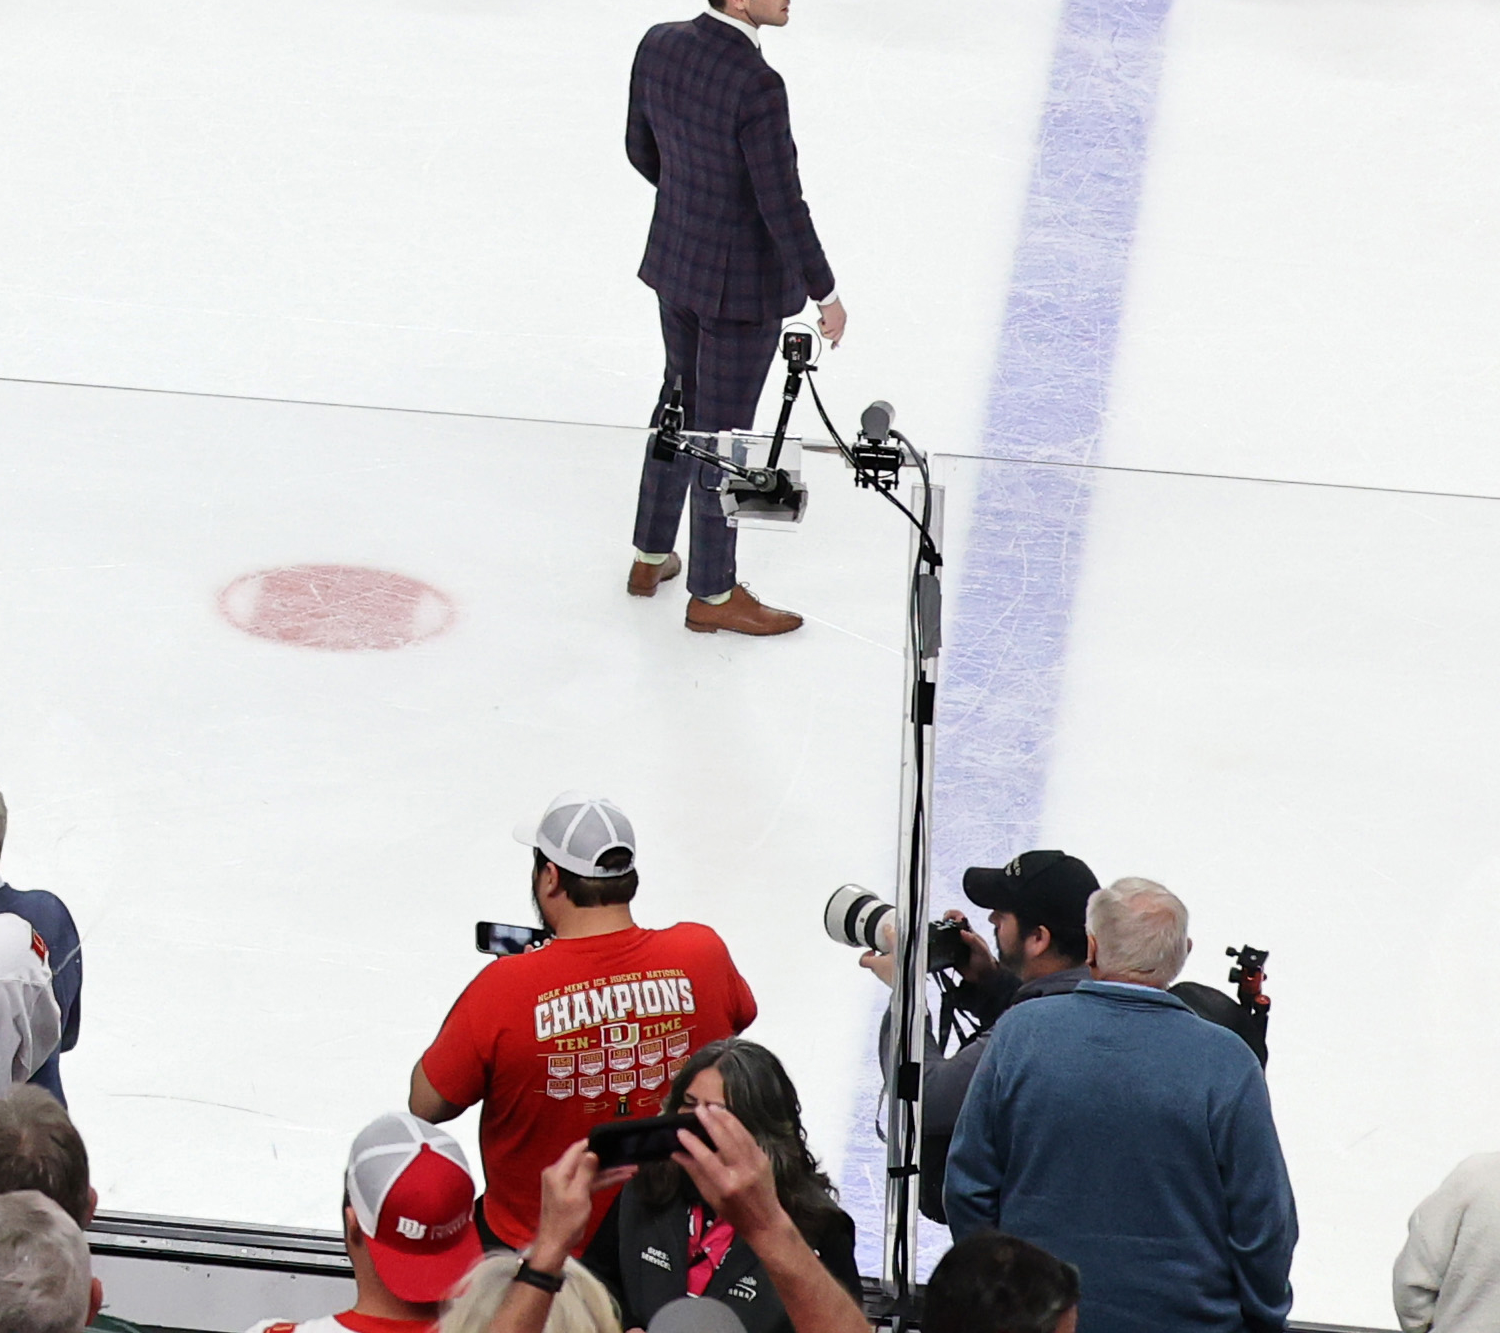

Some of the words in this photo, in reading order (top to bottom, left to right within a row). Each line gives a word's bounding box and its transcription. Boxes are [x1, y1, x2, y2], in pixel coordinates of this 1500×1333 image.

[536, 991, 560, 1004] NCAA
[562, 982, 589, 996] MEN'S
[591, 978, 605, 990] ICE
[607, 973, 643, 989] HOCKEY
[644, 968, 686, 983] NATIONAL
[533, 976, 697, 1042] CHAMPIONS
[600, 1022, 639, 1049] DU
[642, 1018, 682, 1037] TIME
[553, 1034, 596, 1052] TEN-
[610, 1073, 633, 1085] 2017
